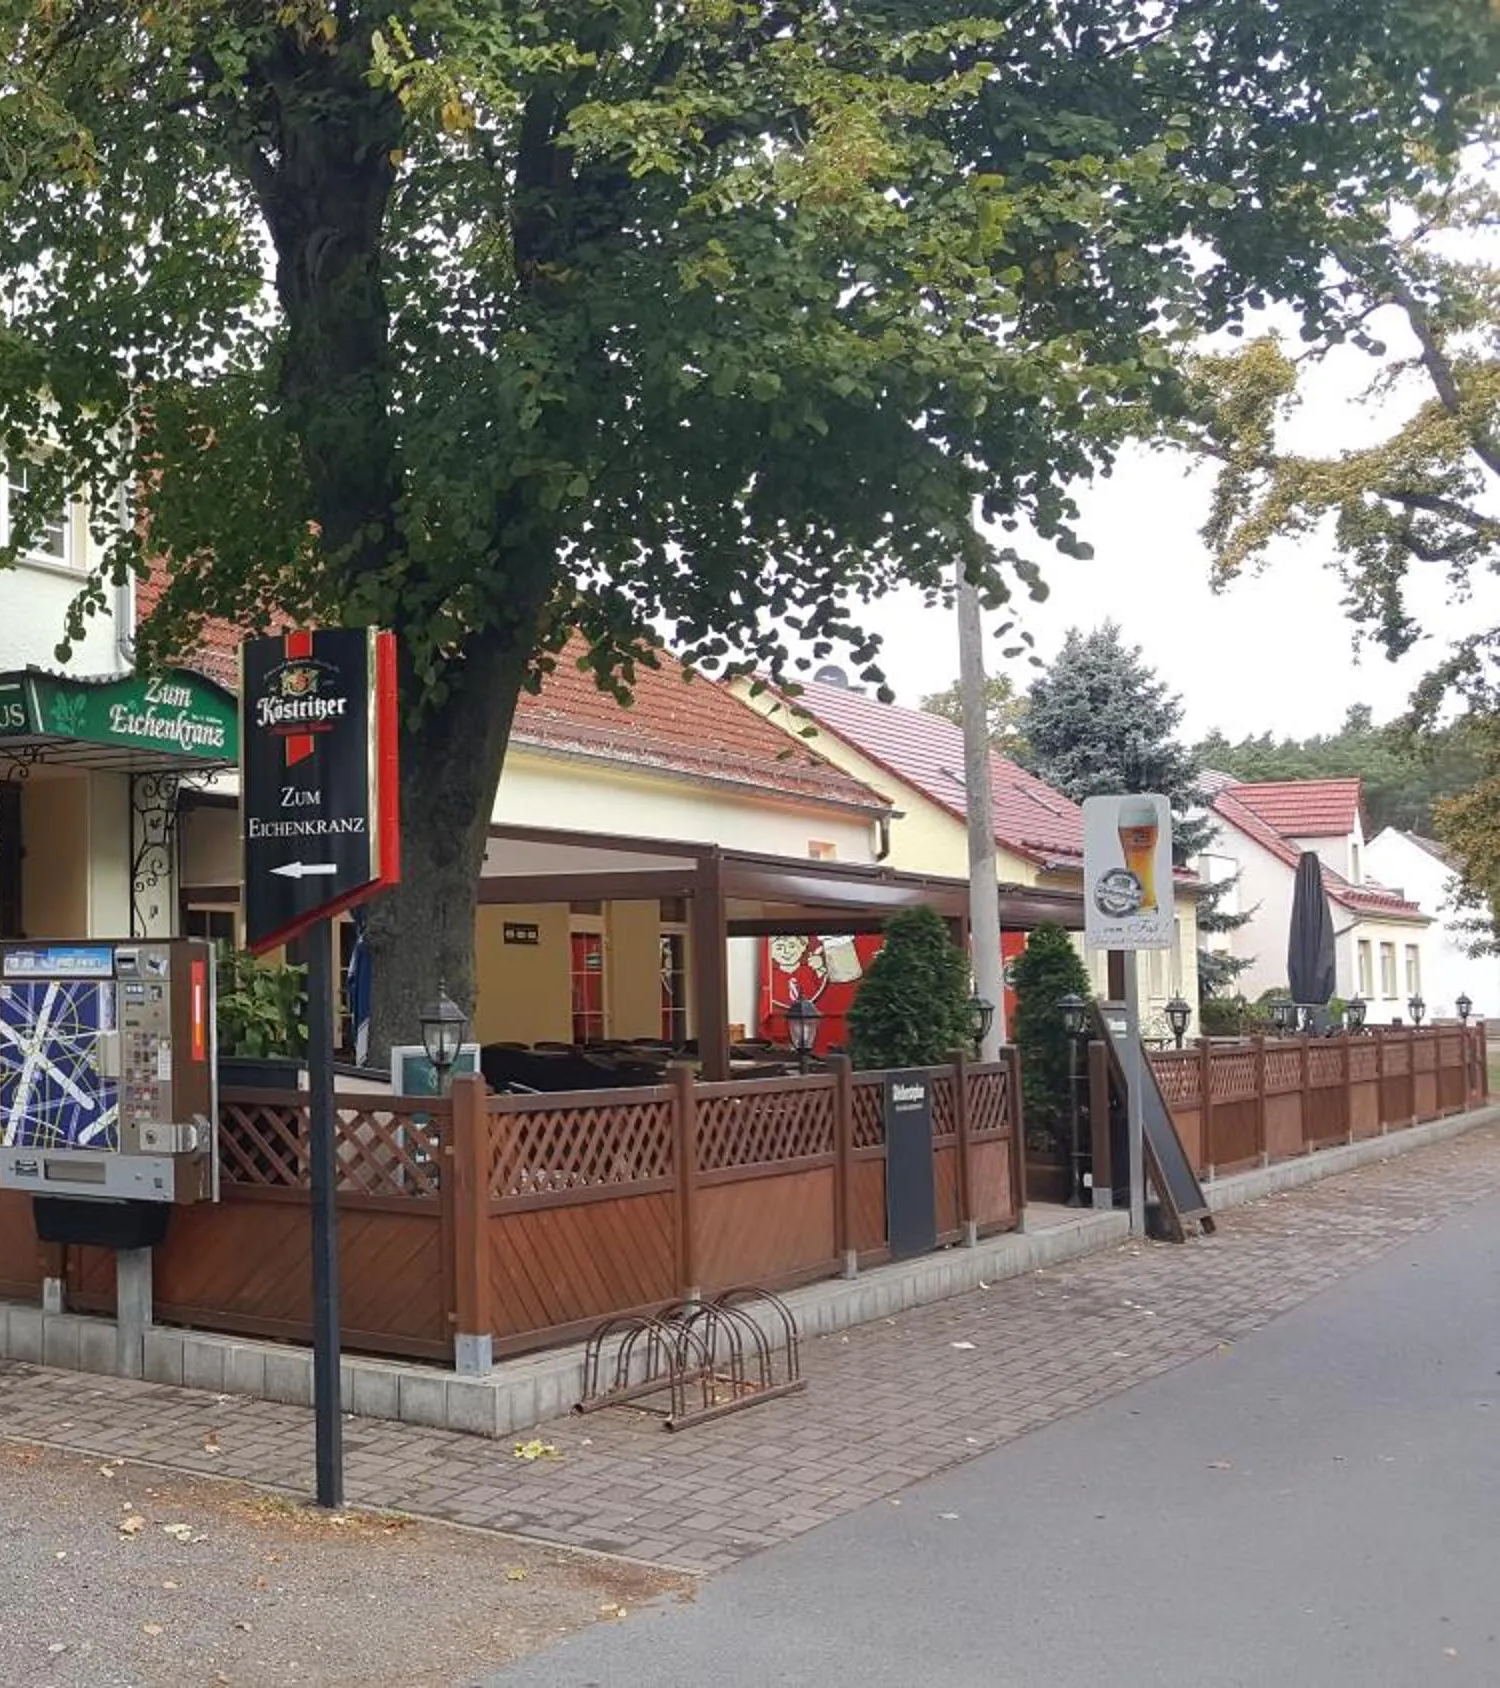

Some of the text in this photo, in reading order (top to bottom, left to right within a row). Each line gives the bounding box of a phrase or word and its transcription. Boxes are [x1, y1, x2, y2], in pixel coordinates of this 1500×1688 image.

[144, 677, 193, 708] Zum
[256, 695, 348, 726] Köstritzer
[109, 703, 225, 751] Eichenkranz
